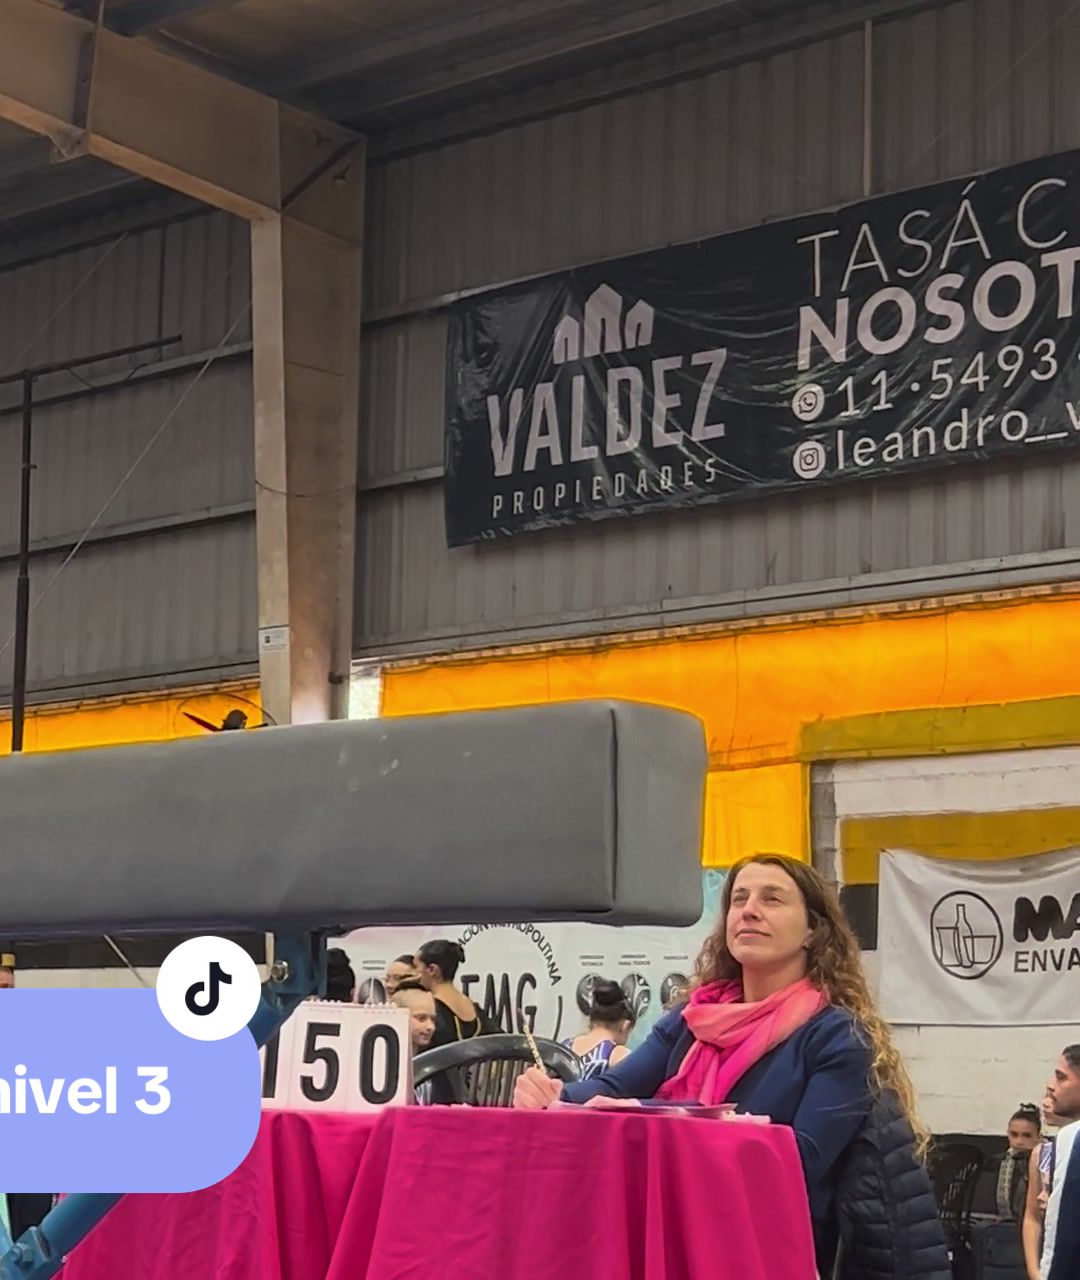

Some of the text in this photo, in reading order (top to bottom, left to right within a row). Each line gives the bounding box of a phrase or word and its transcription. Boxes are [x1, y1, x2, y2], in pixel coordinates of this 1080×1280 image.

[796, 180, 991, 297] TASÁ
[797, 247, 1080, 371] NOSOT
[486, 347, 727, 477] VALDEZ
[492, 458, 717, 519] PROPIEDADES
